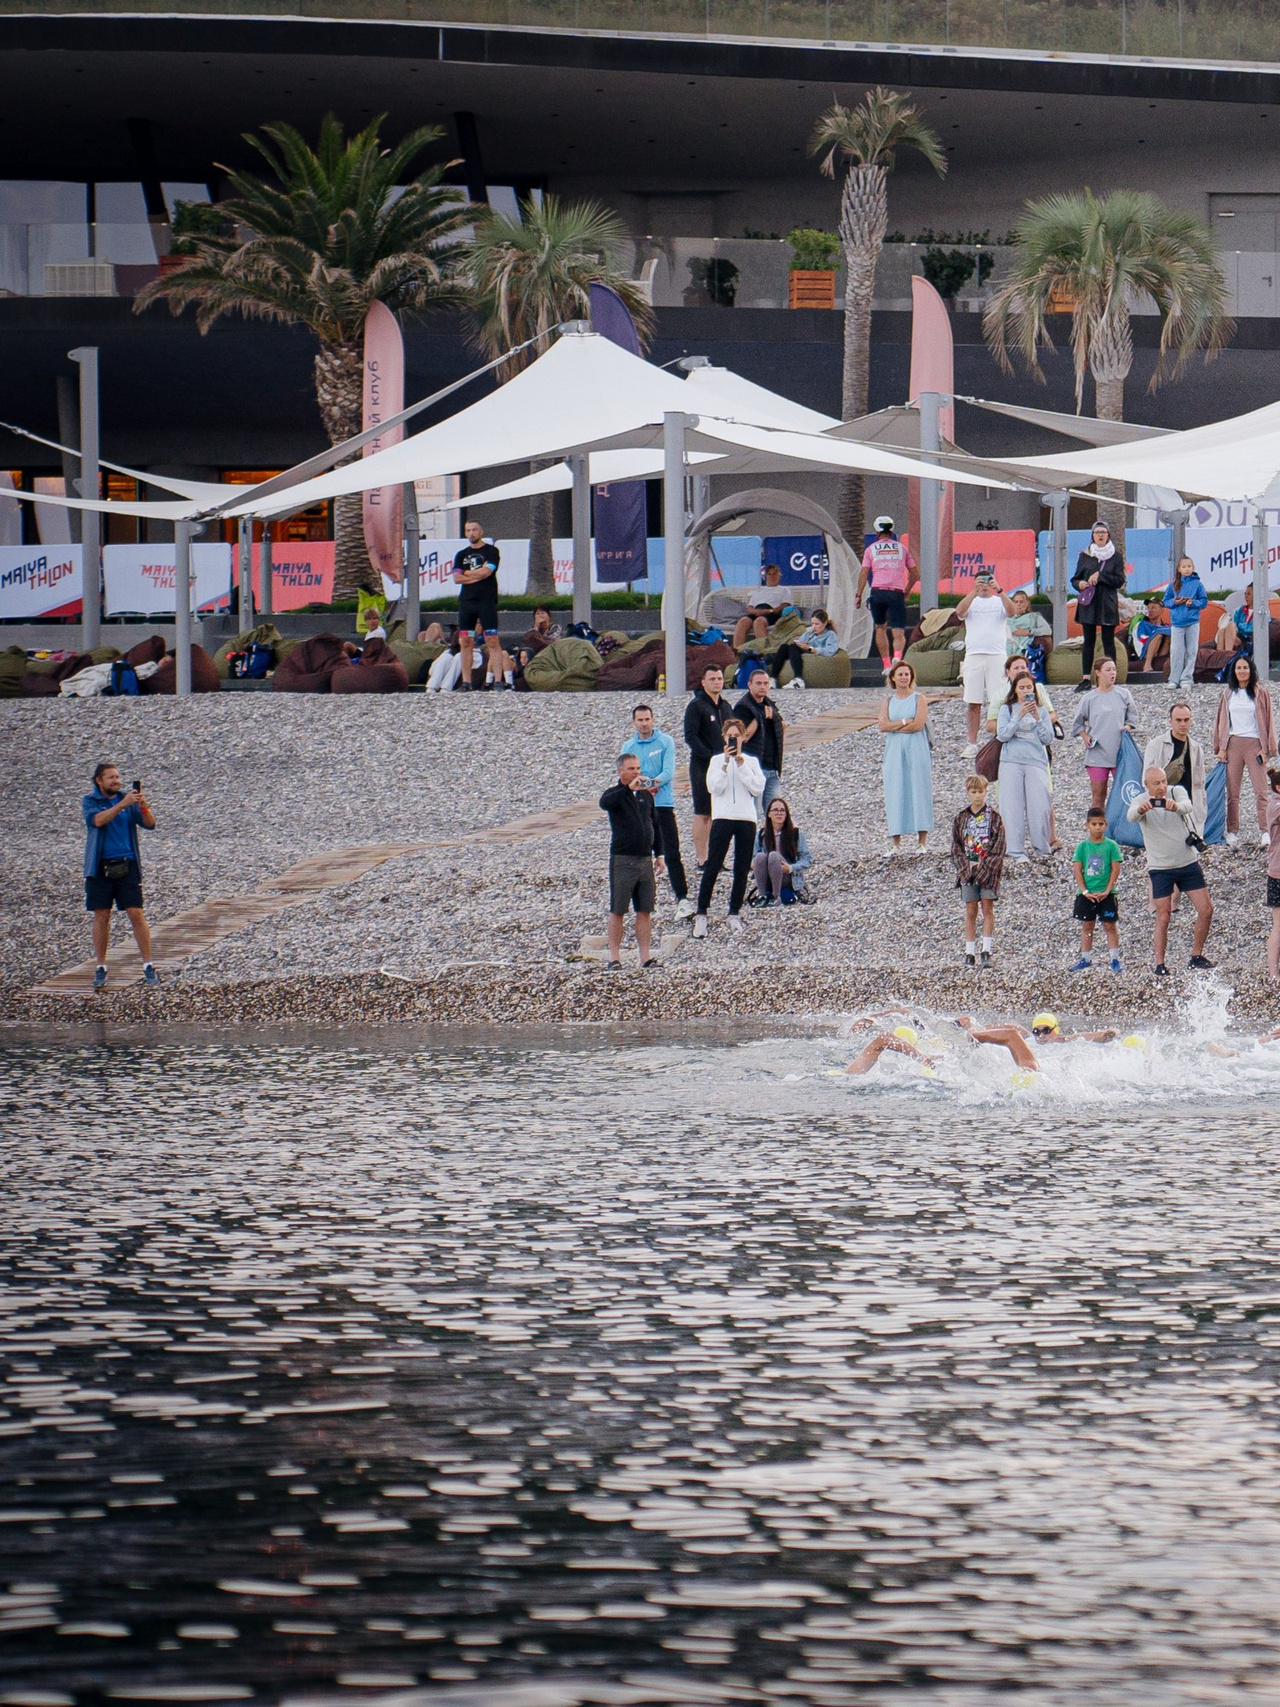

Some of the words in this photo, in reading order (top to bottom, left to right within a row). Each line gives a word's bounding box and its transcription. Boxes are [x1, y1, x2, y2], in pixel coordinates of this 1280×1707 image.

[368, 360, 382, 406] клуб
[953, 552, 984, 565] RIYA
[1211, 541, 1253, 572] MRIY
[28, 560, 73, 590] THLON
[141, 565, 177, 576] MRIY
[278, 574, 323, 586] THLON
[419, 560, 453, 586] THLO
